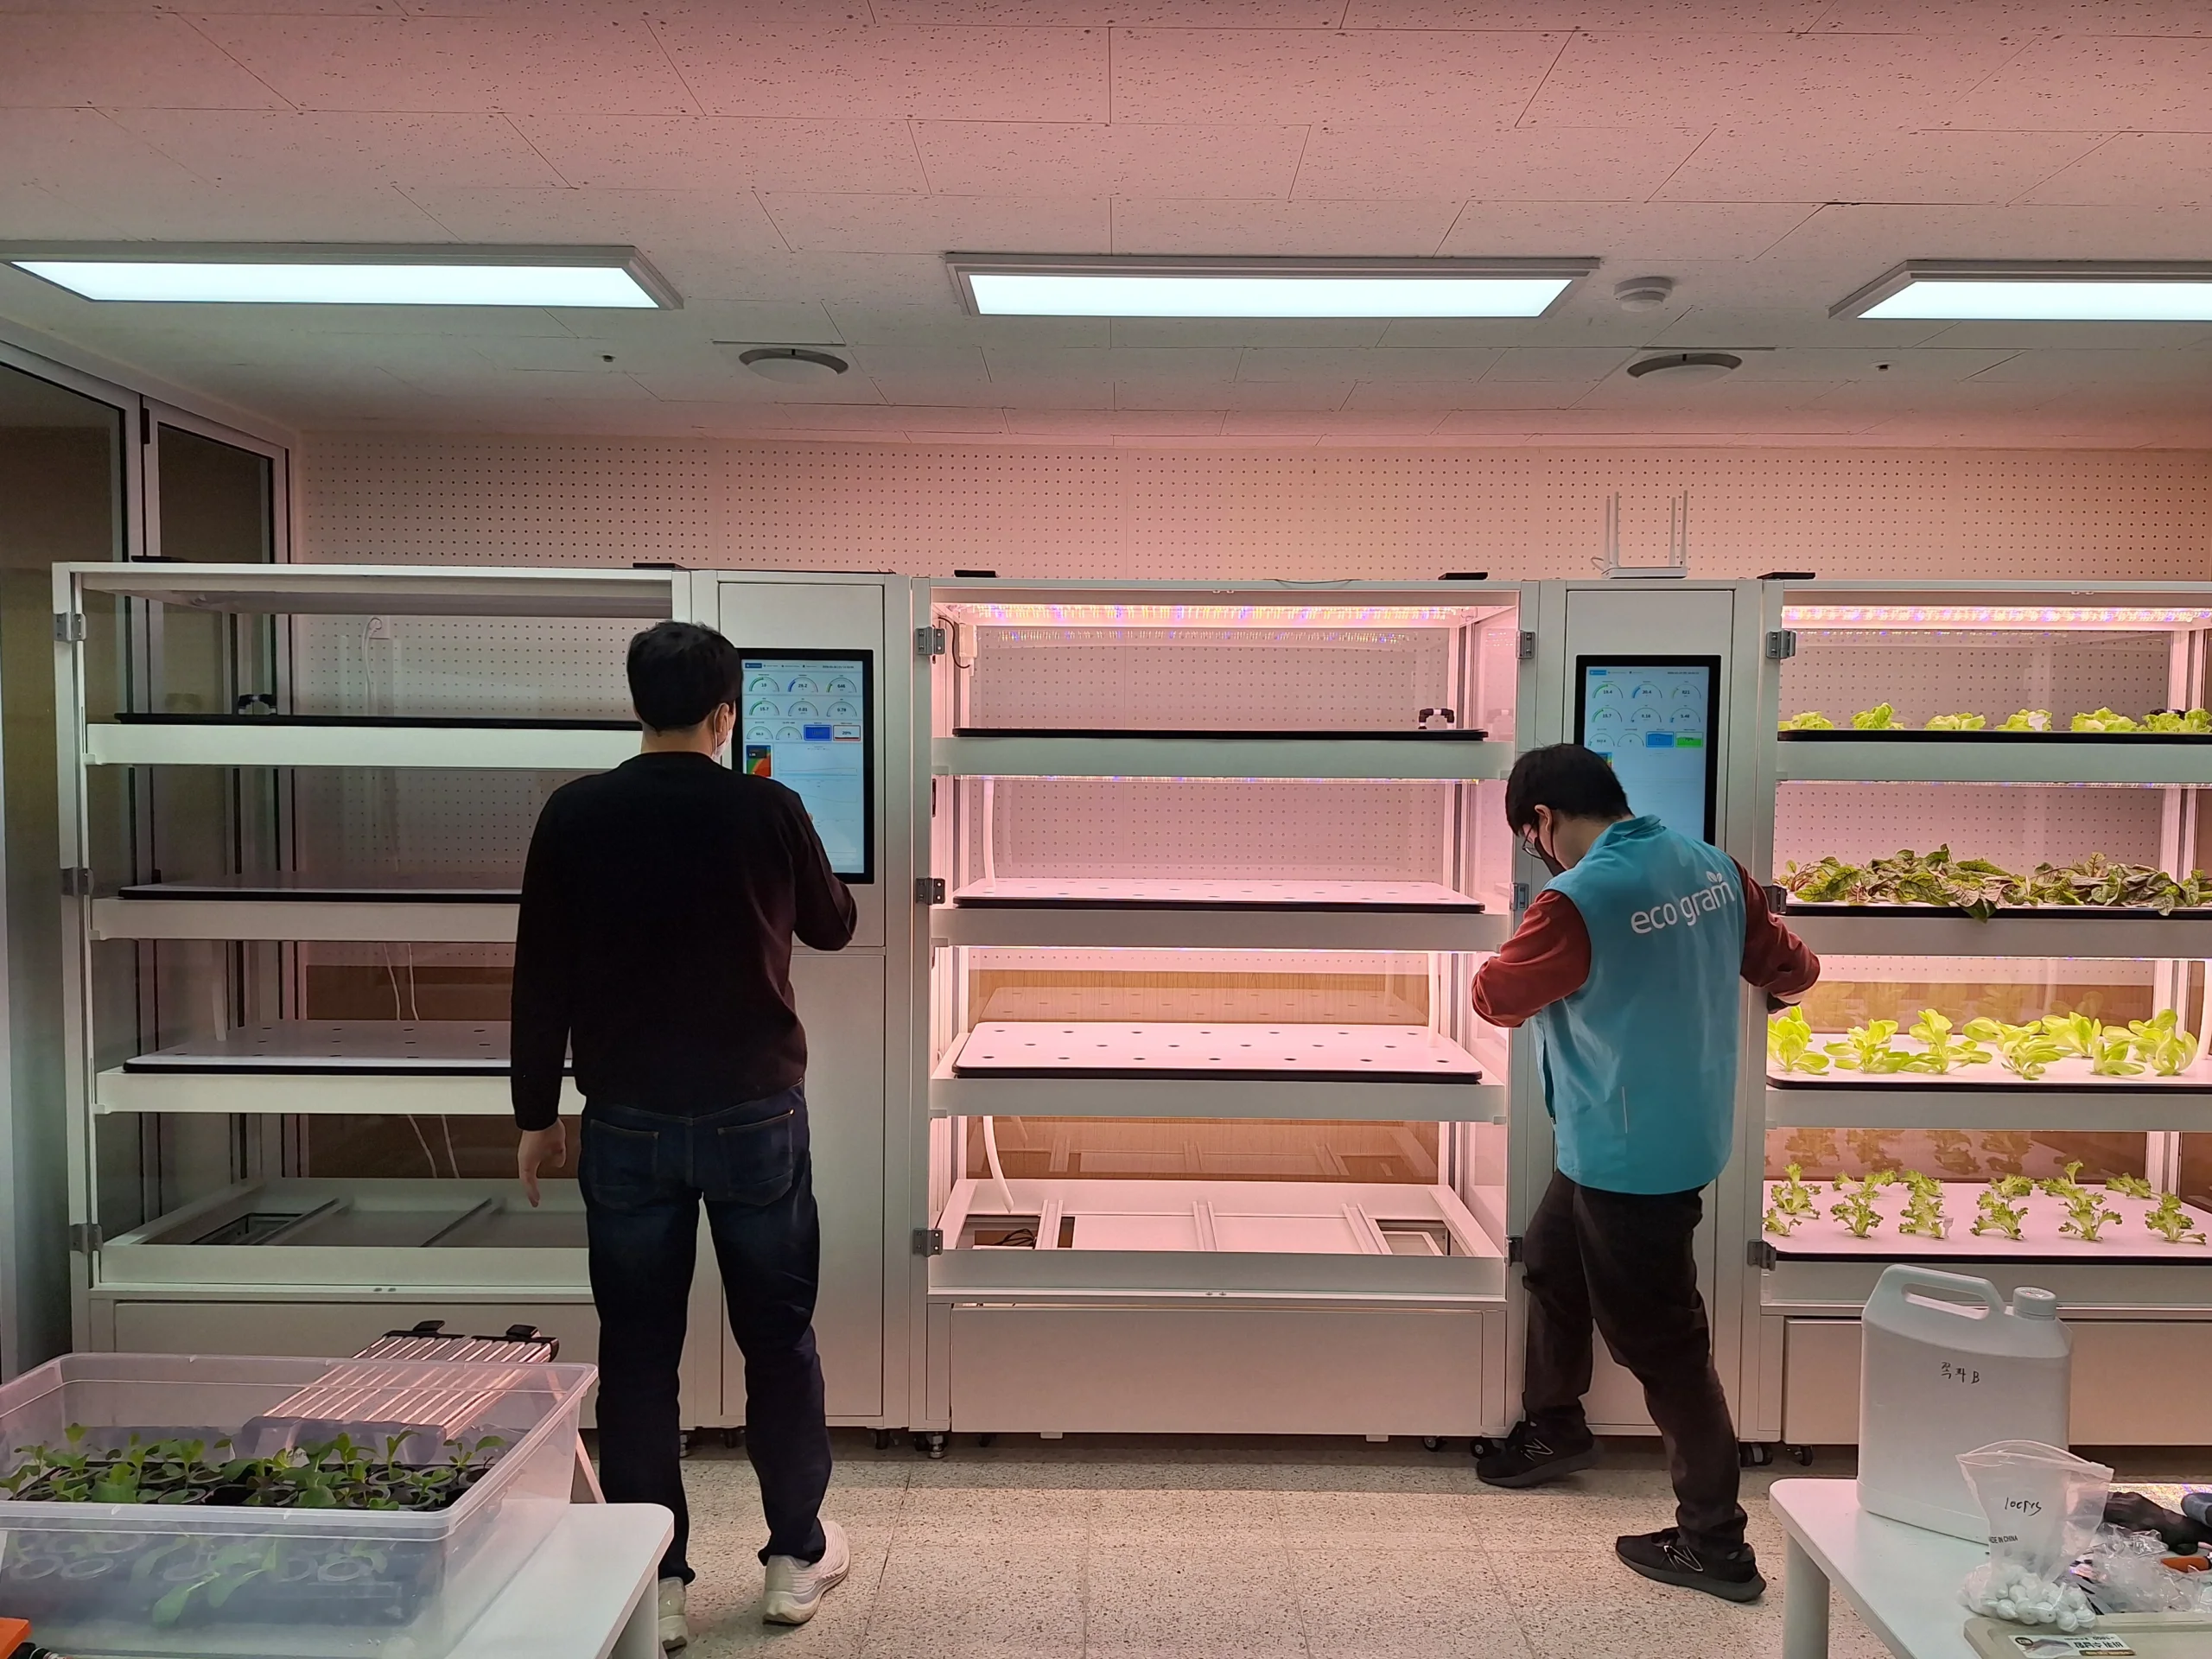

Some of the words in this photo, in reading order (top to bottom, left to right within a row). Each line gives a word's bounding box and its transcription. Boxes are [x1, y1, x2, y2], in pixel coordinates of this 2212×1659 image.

[1630, 902, 1678, 934] eco
[1680, 880, 1735, 926] gram
[1971, 1370, 1980, 1384] B
